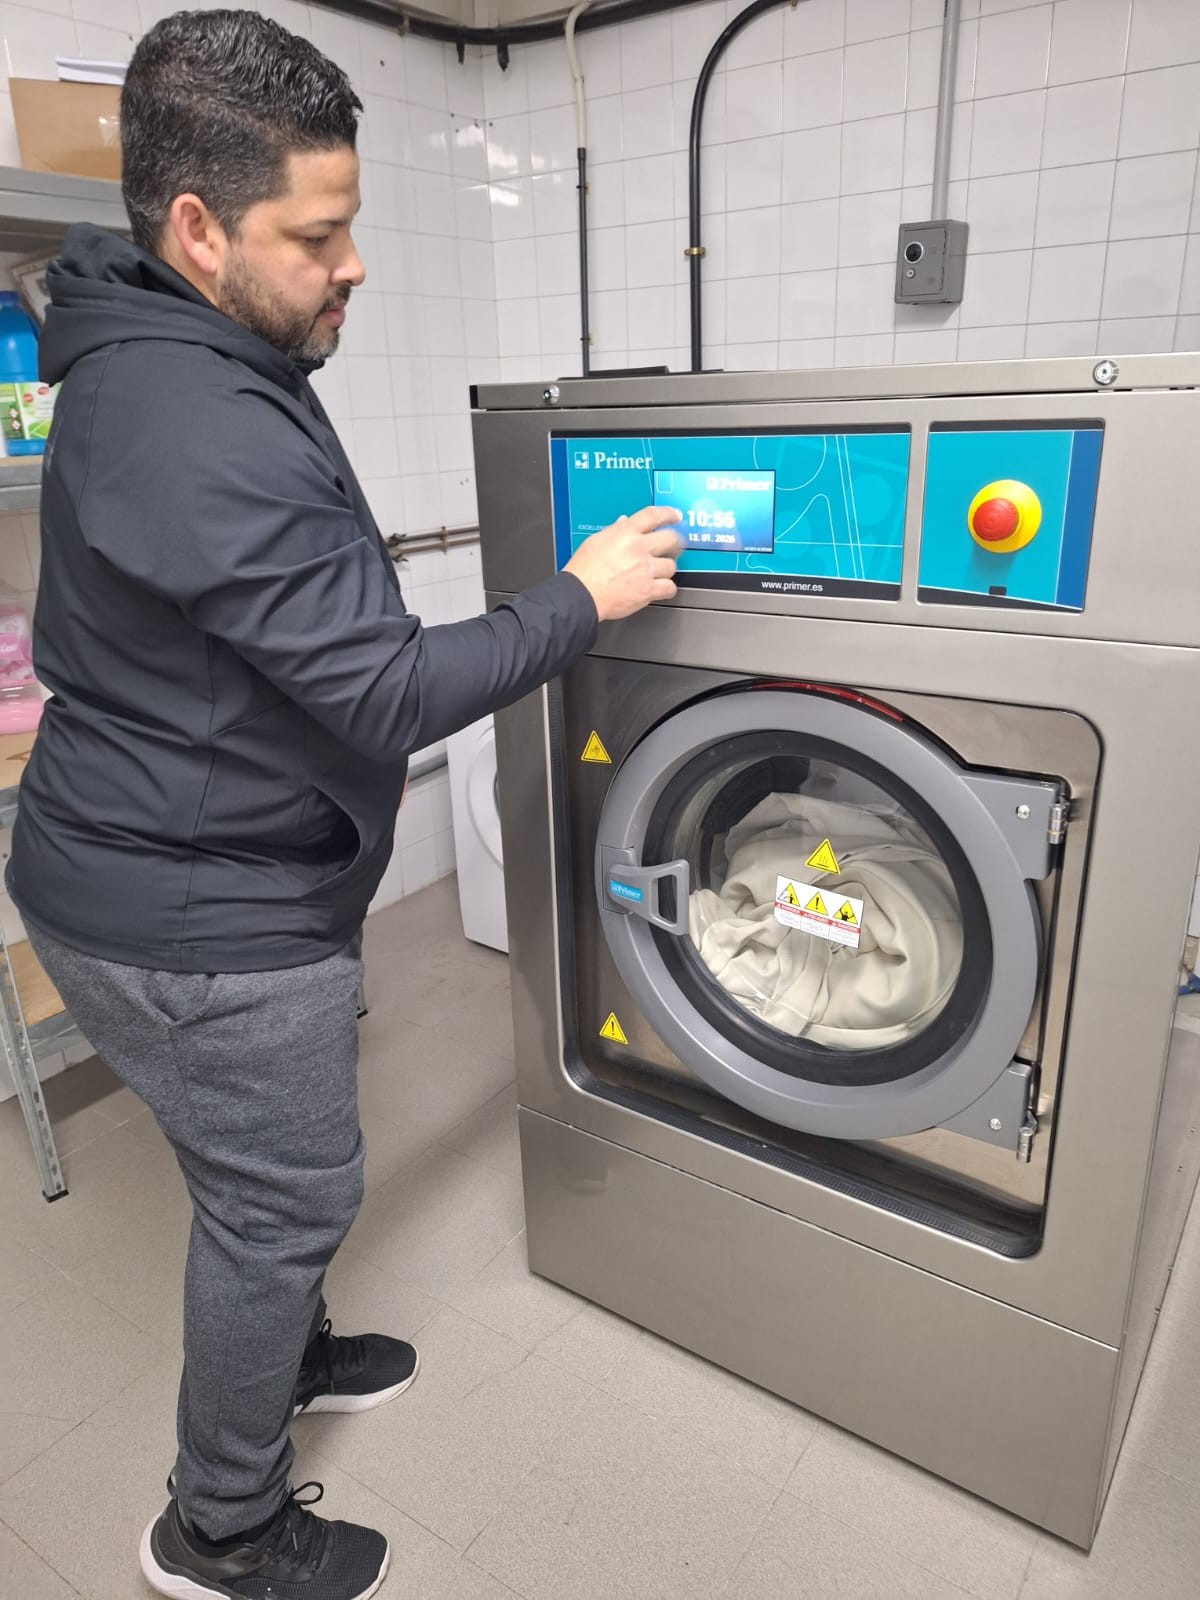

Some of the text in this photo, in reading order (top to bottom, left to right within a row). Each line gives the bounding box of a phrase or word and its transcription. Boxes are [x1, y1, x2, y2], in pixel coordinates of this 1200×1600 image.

[594, 451, 652, 469] Primer
[720, 477, 771, 490] Primer
[687, 510, 736, 528] 10:56
[761, 581, 823, 592] www.primer.es
[617, 884, 641, 899] Primer
